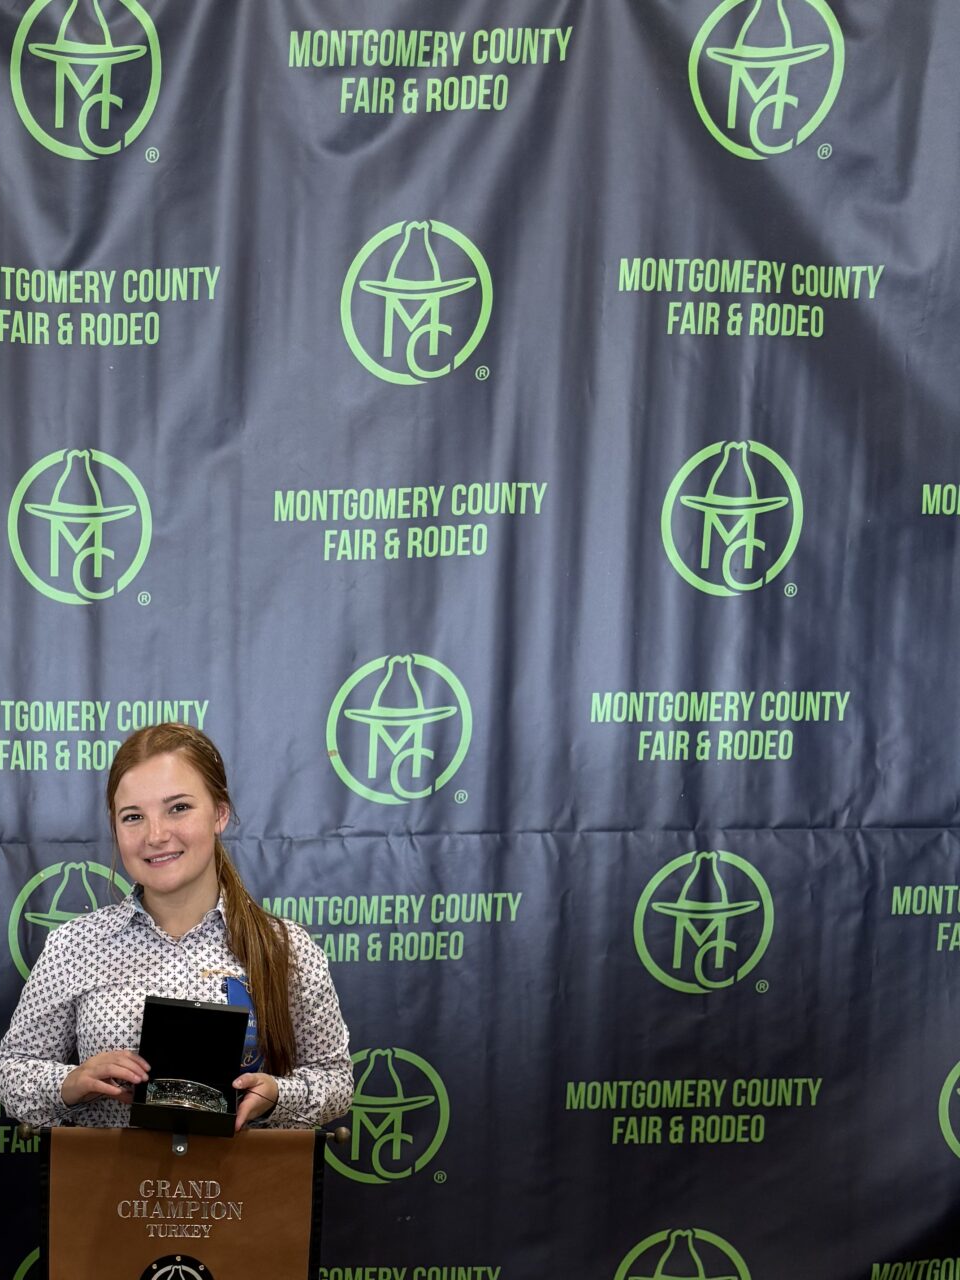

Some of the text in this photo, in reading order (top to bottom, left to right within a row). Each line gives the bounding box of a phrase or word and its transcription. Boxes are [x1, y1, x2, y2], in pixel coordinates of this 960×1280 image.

[288, 27, 572, 67] MONTGOMERY COUNTY
[340, 75, 509, 114] FAIR & RODEO
[123, 266, 220, 304] COUNTY
[618, 258, 884, 300] MONTGOMERY COUNTY
[57, 312, 74, 345] &
[80, 311, 160, 346] RODEO
[667, 302, 825, 338] FAIR & RODEO
[273, 482, 546, 523] MONTGOMERY COUNTY
[323, 525, 488, 562] FAIR & RODEO
[117, 699, 209, 731] COUNTY
[591, 691, 850, 722] MONTGOMERY COUNTY
[55, 740, 71, 770] &
[638, 730, 793, 761] FAIR & RODEO
[263, 892, 523, 925] MONTGOMERY COUNTY
[367, 933, 383, 961] &
[389, 931, 464, 961] RODEO
[566, 1079, 823, 1110] MONTGOMERY COUNTY
[613, 1114, 766, 1144] FAIR & RODEO
[139, 1179, 221, 1199] GRAND
[117, 1200, 243, 1220] CHAMPION
[146, 1223, 213, 1238] TURKEY
